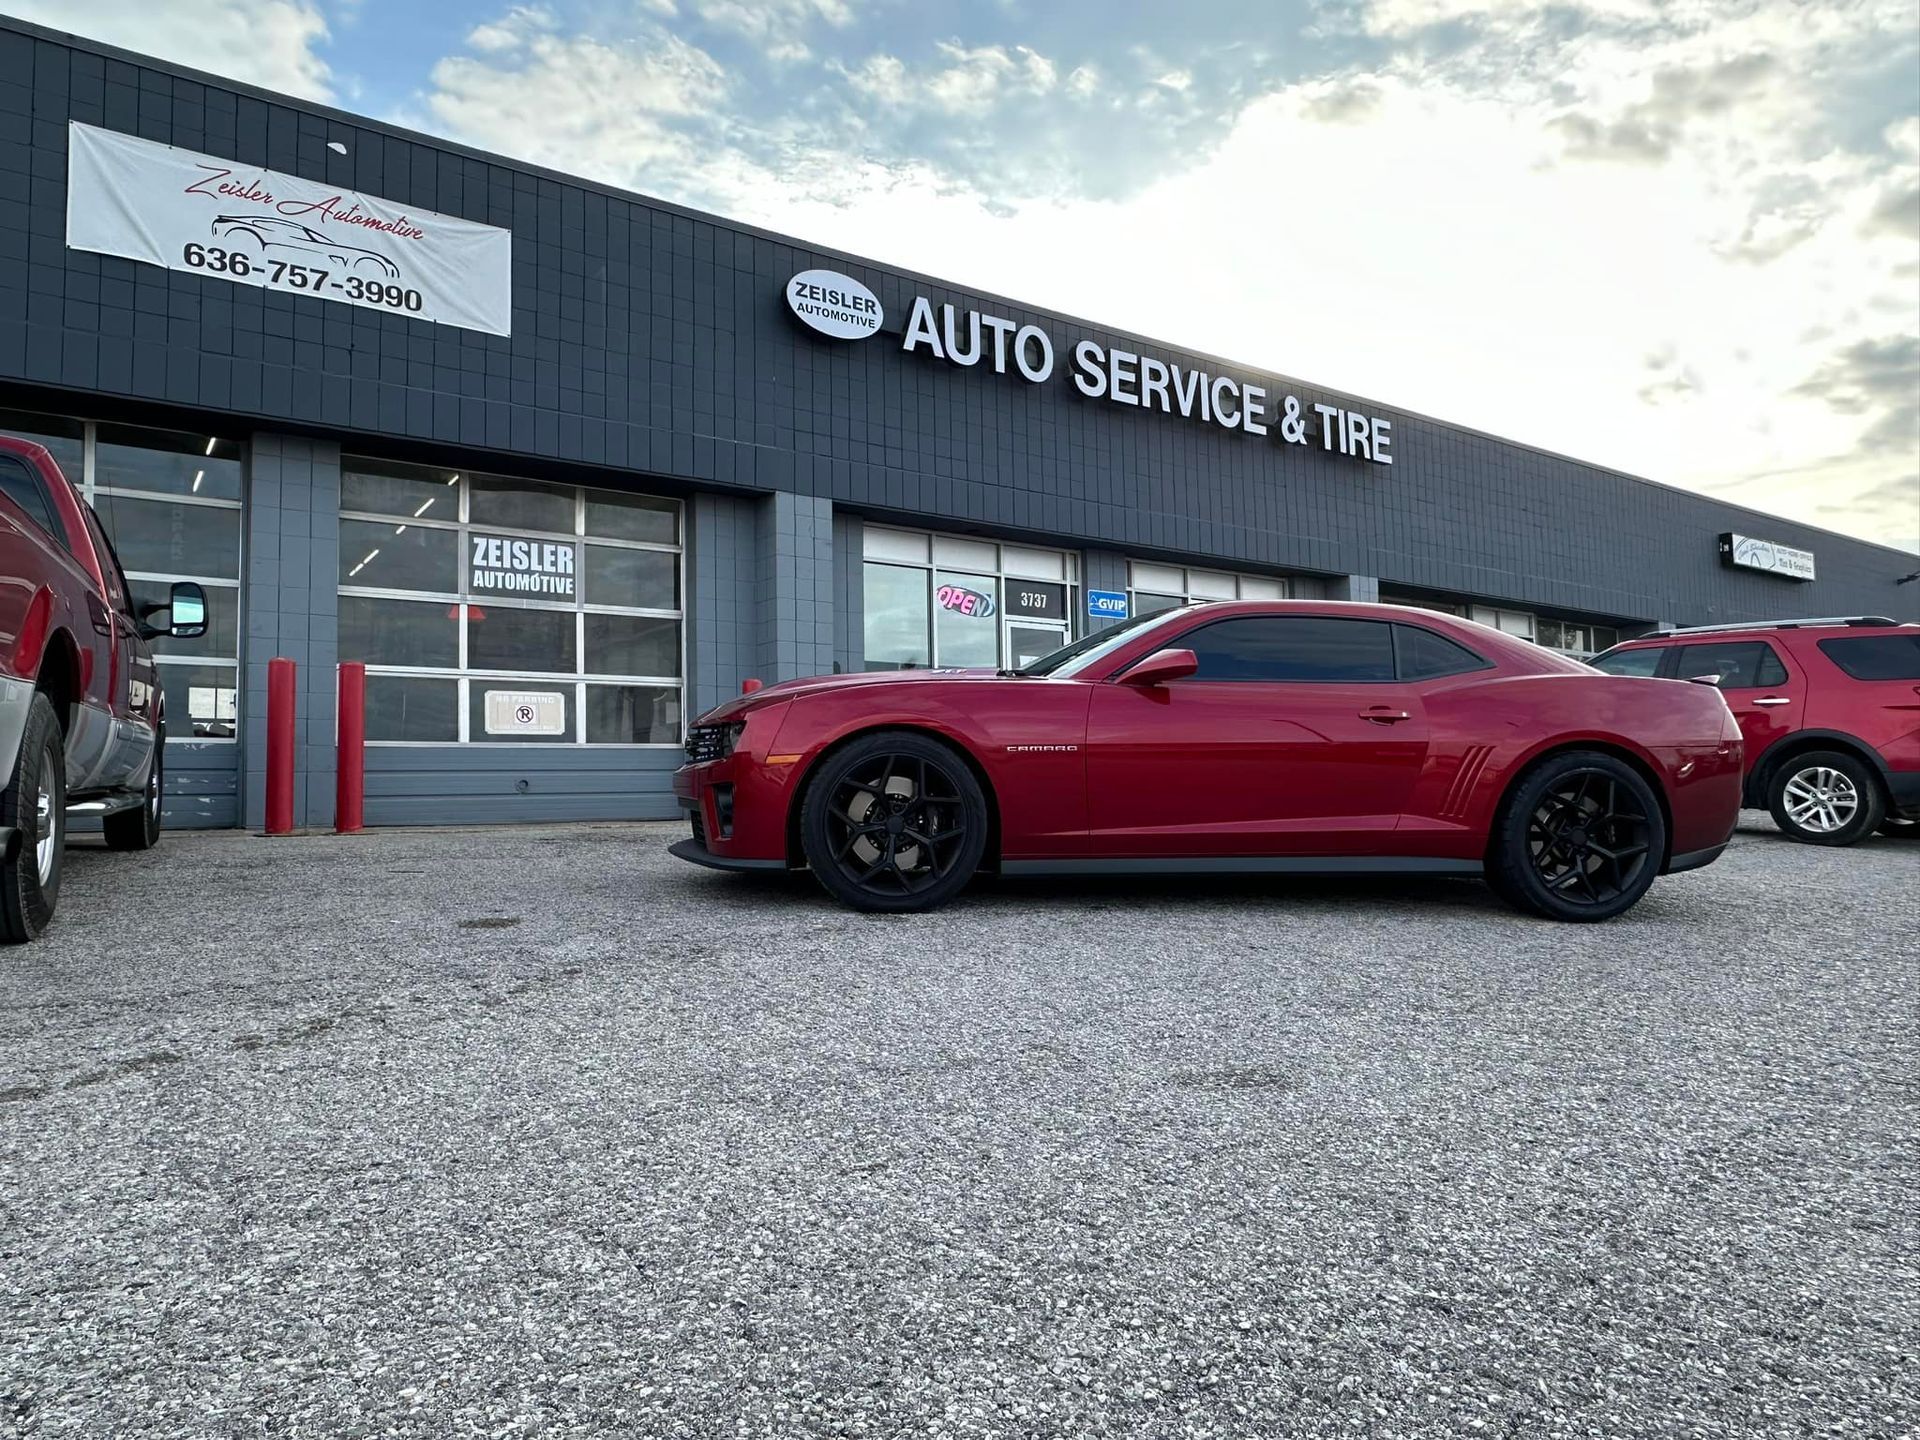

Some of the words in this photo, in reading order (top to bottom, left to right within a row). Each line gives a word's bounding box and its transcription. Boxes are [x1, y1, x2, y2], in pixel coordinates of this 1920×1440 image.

[185, 164, 274, 204] Zeisler
[277, 195, 424, 240] Automotive
[183, 242, 422, 311] 636-757-3990
[795, 281, 877, 315] ZEISLER
[797, 302, 876, 329] AUTOMOTIVE
[903, 296, 1054, 383] AUTO
[1074, 340, 1267, 436] SERVICE
[1281, 395, 1307, 445] &
[1314, 403, 1393, 464] TIRE
[473, 537, 574, 574] ZEISLER
[473, 569, 574, 594] AUTOMOTIVE
[938, 586, 987, 617] OPEN
[1021, 592, 1047, 608] 3737
[1098, 598, 1126, 611] GVIP
